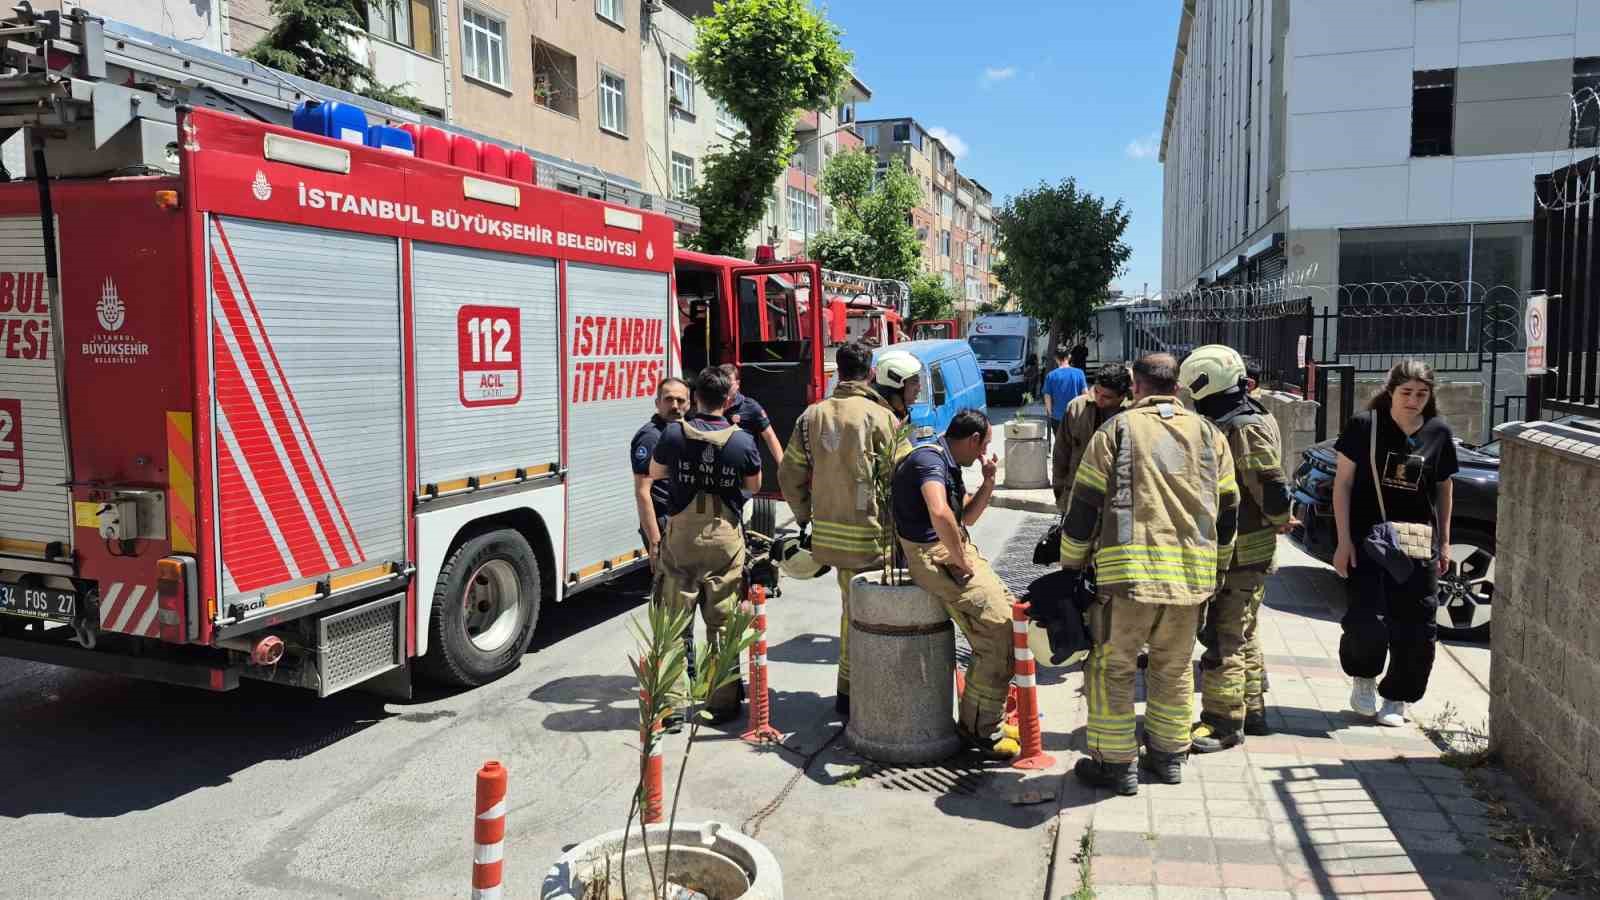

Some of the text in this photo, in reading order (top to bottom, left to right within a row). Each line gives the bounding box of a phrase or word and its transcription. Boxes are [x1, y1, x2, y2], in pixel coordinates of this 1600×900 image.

[298, 181, 637, 257] İSTANBUL BÜYÜKŞEHİR BELEDİYESİ
[81, 340, 149, 356] BÜYÜKŞEHİR
[467, 317, 513, 363] 112
[572, 316, 664, 356] İSTANBUL
[572, 360, 664, 403] İTFAİYESİ
[1, 587, 16, 606] 34
[25, 589, 48, 610] FOS
[57, 594, 73, 613] 27
